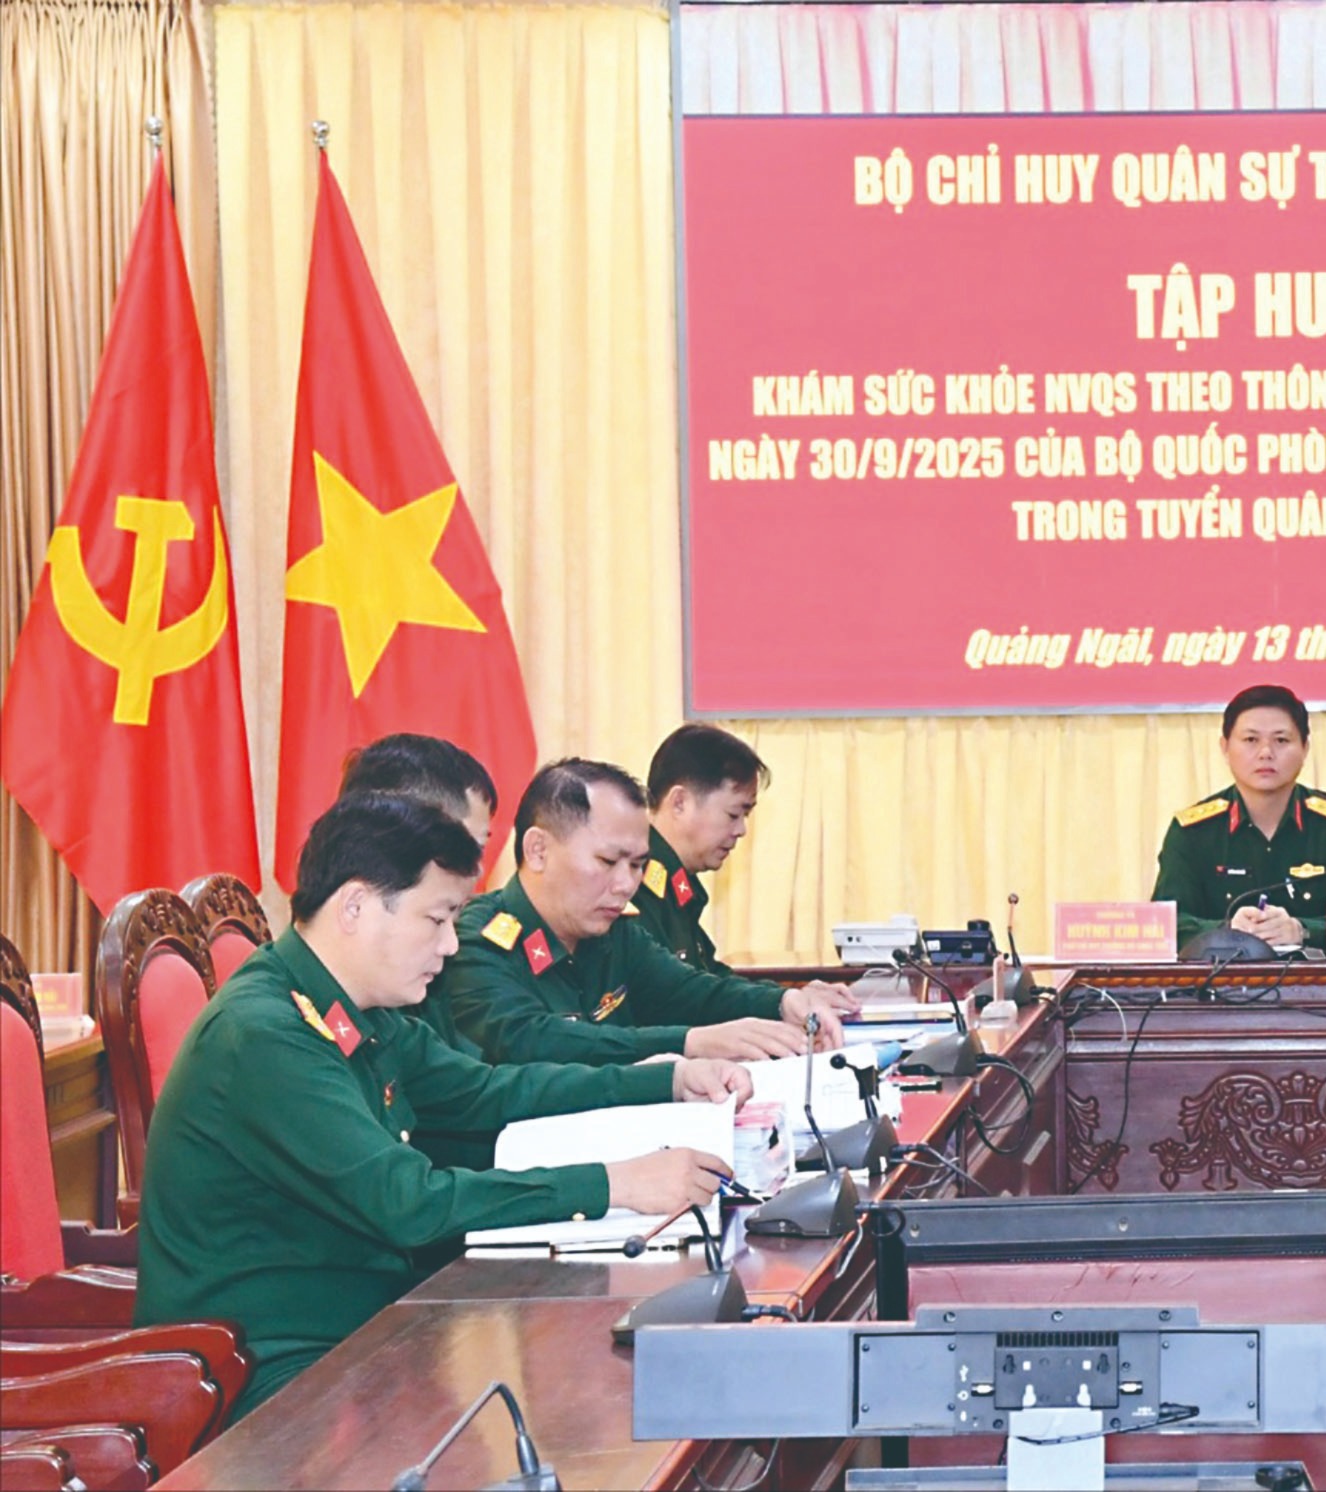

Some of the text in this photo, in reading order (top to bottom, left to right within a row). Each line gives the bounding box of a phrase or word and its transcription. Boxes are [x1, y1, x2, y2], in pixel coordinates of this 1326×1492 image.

[854, 146, 913, 214] BỘ
[926, 143, 1001, 206] CHỈ
[1014, 153, 1100, 204] HUY
[1111, 143, 1227, 208] QUÂN
[1239, 143, 1301, 210] SỰ
[1126, 262, 1236, 352] TẬP
[752, 369, 855, 417] KHÁM
[863, 368, 935, 416] SỨC
[945, 364, 1036, 415] KHỎE
[1044, 371, 1138, 418] NVQS
[1145, 370, 1233, 412] THEO
[708, 432, 801, 481] NGÀY
[809, 436, 1005, 480] 30/9/2025
[1014, 426, 1086, 478] CỦA
[1094, 428, 1143, 483] BỘ
[1152, 421, 1248, 480] QUỐC
[1011, 498, 1127, 541] TRONG
[1135, 484, 1243, 540] TUYỂN
[964, 625, 1072, 670] Quảng
[1074, 626, 1154, 669] Ngãi,
[1161, 625, 1247, 667] ngày
[1252, 624, 1291, 662] 13
